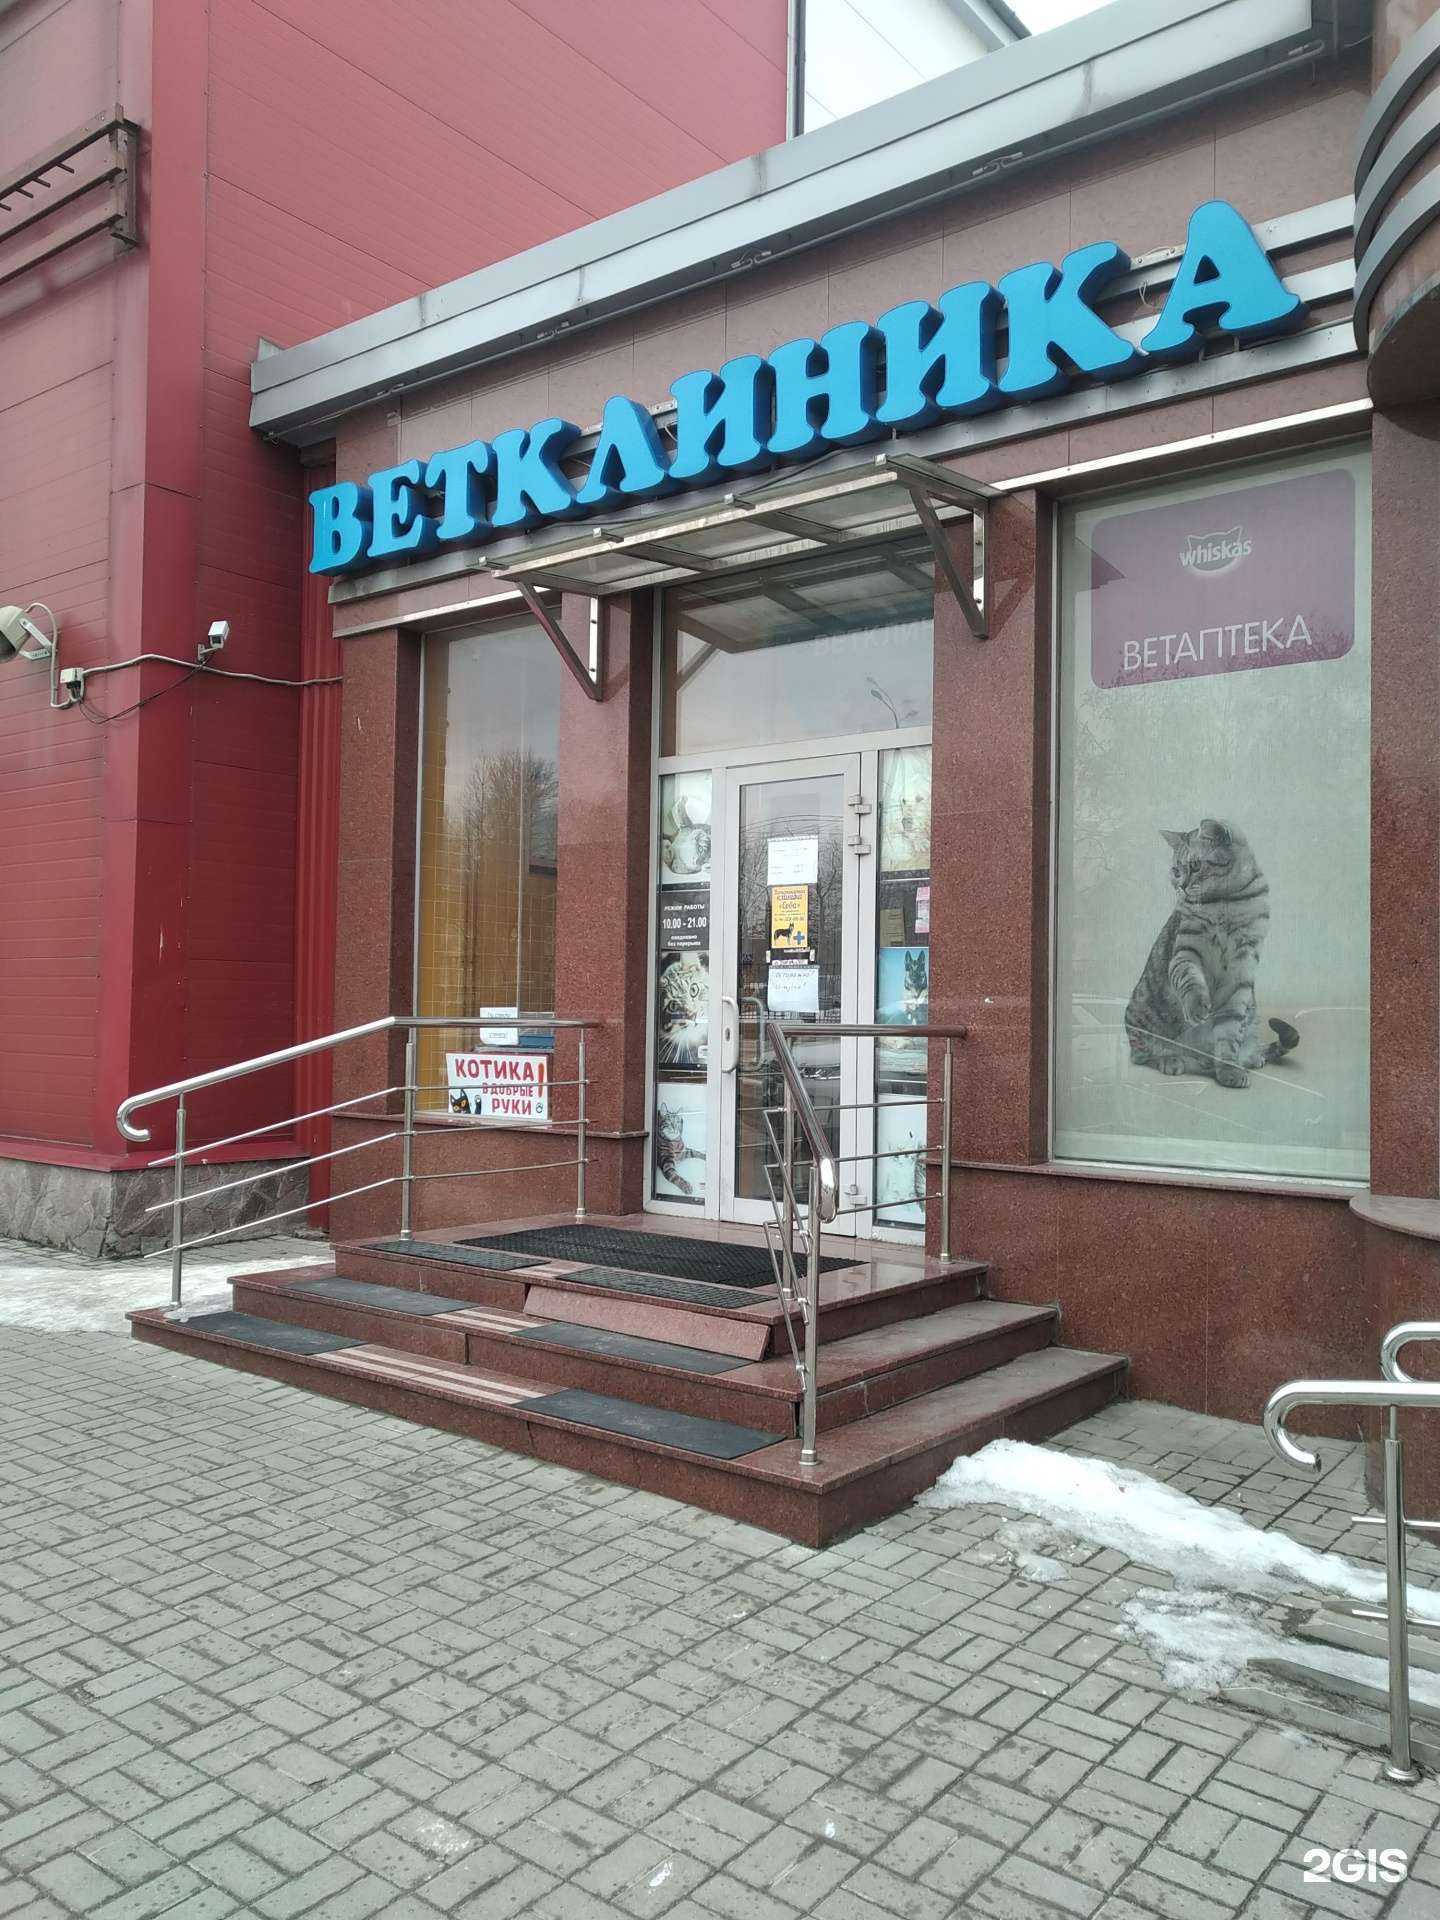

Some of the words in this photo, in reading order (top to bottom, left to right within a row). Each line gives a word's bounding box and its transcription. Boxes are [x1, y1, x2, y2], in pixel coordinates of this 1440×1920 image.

[307, 200, 1304, 576] ВЕТКЛИНИКА
[1123, 614, 1313, 671] ВЕТАПТЕКА
[662, 917, 681, 929] 10.00
[687, 916, 707, 928] 21.00
[490, 1082, 534, 1097] ДОБРЫЕ
[491, 1098, 532, 1116] РУКИ
